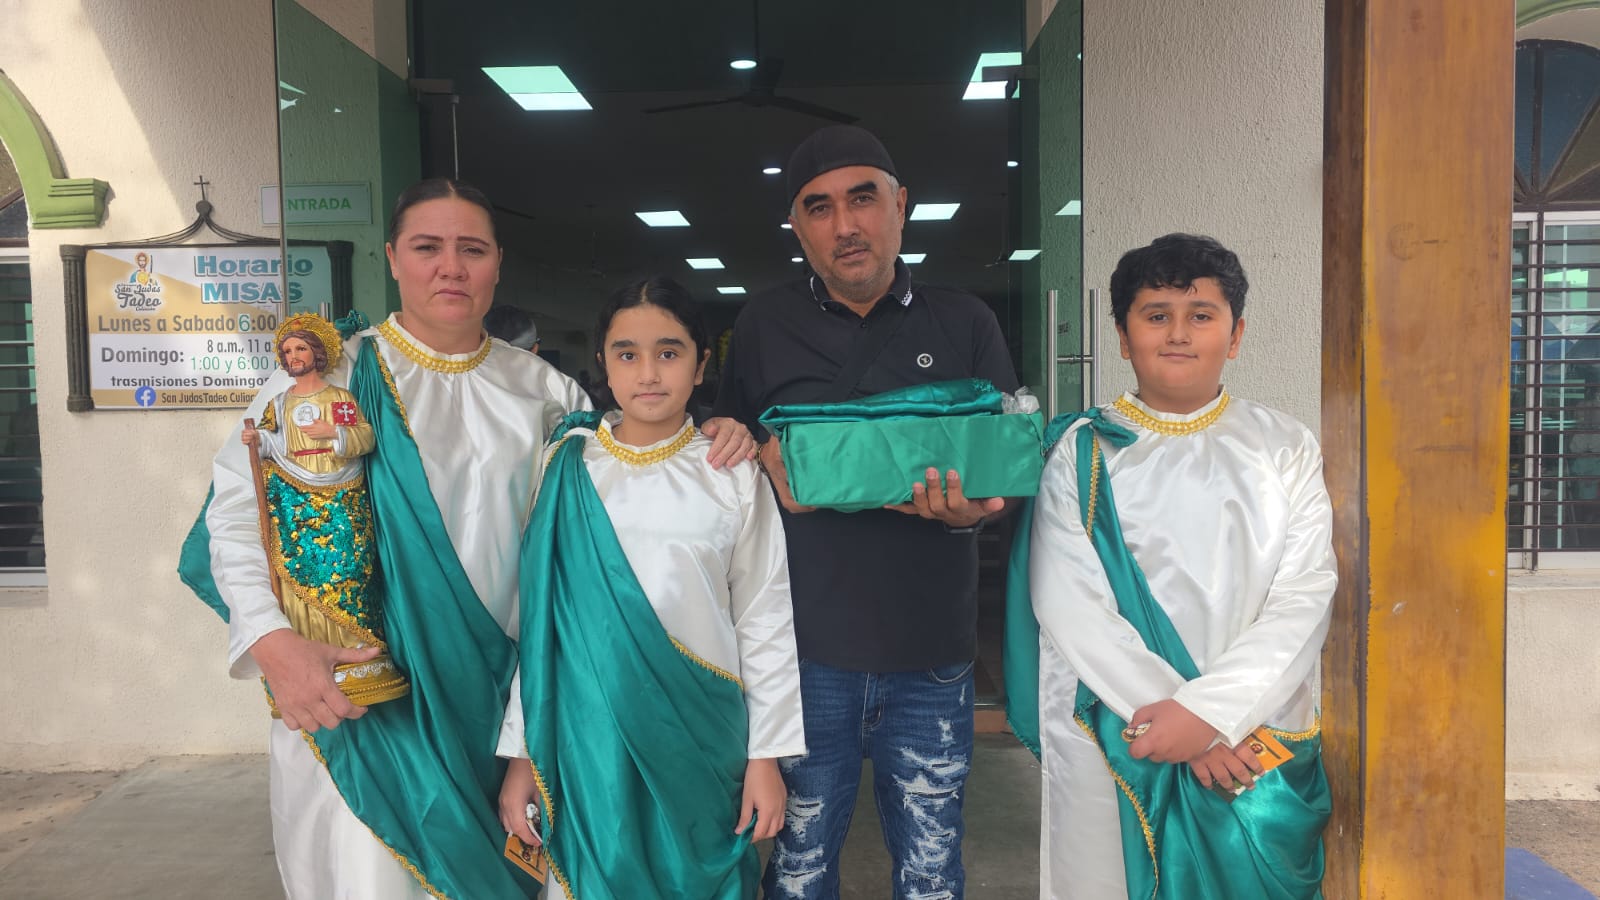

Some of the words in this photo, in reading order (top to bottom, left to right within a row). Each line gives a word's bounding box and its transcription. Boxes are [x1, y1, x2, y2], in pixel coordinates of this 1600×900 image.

[285, 197, 352, 211] NTRADA
[195, 254, 313, 277] Horario
[117, 290, 162, 308] Tadeo
[201, 282, 303, 304] MISAS
[98, 315, 151, 332] Lunes
[157, 318, 167, 332] a
[173, 315, 235, 332] Sabado
[238, 314, 277, 332] 6:00
[207, 339, 214, 353] 8
[248, 339, 259, 353] 11
[101, 347, 184, 366] Domingo:
[191, 356, 220, 370] 1:00
[225, 360, 233, 373] y
[237, 356, 269, 370] 6:00
[111, 376, 198, 387] trasmisiones
[161, 392, 177, 403] San
